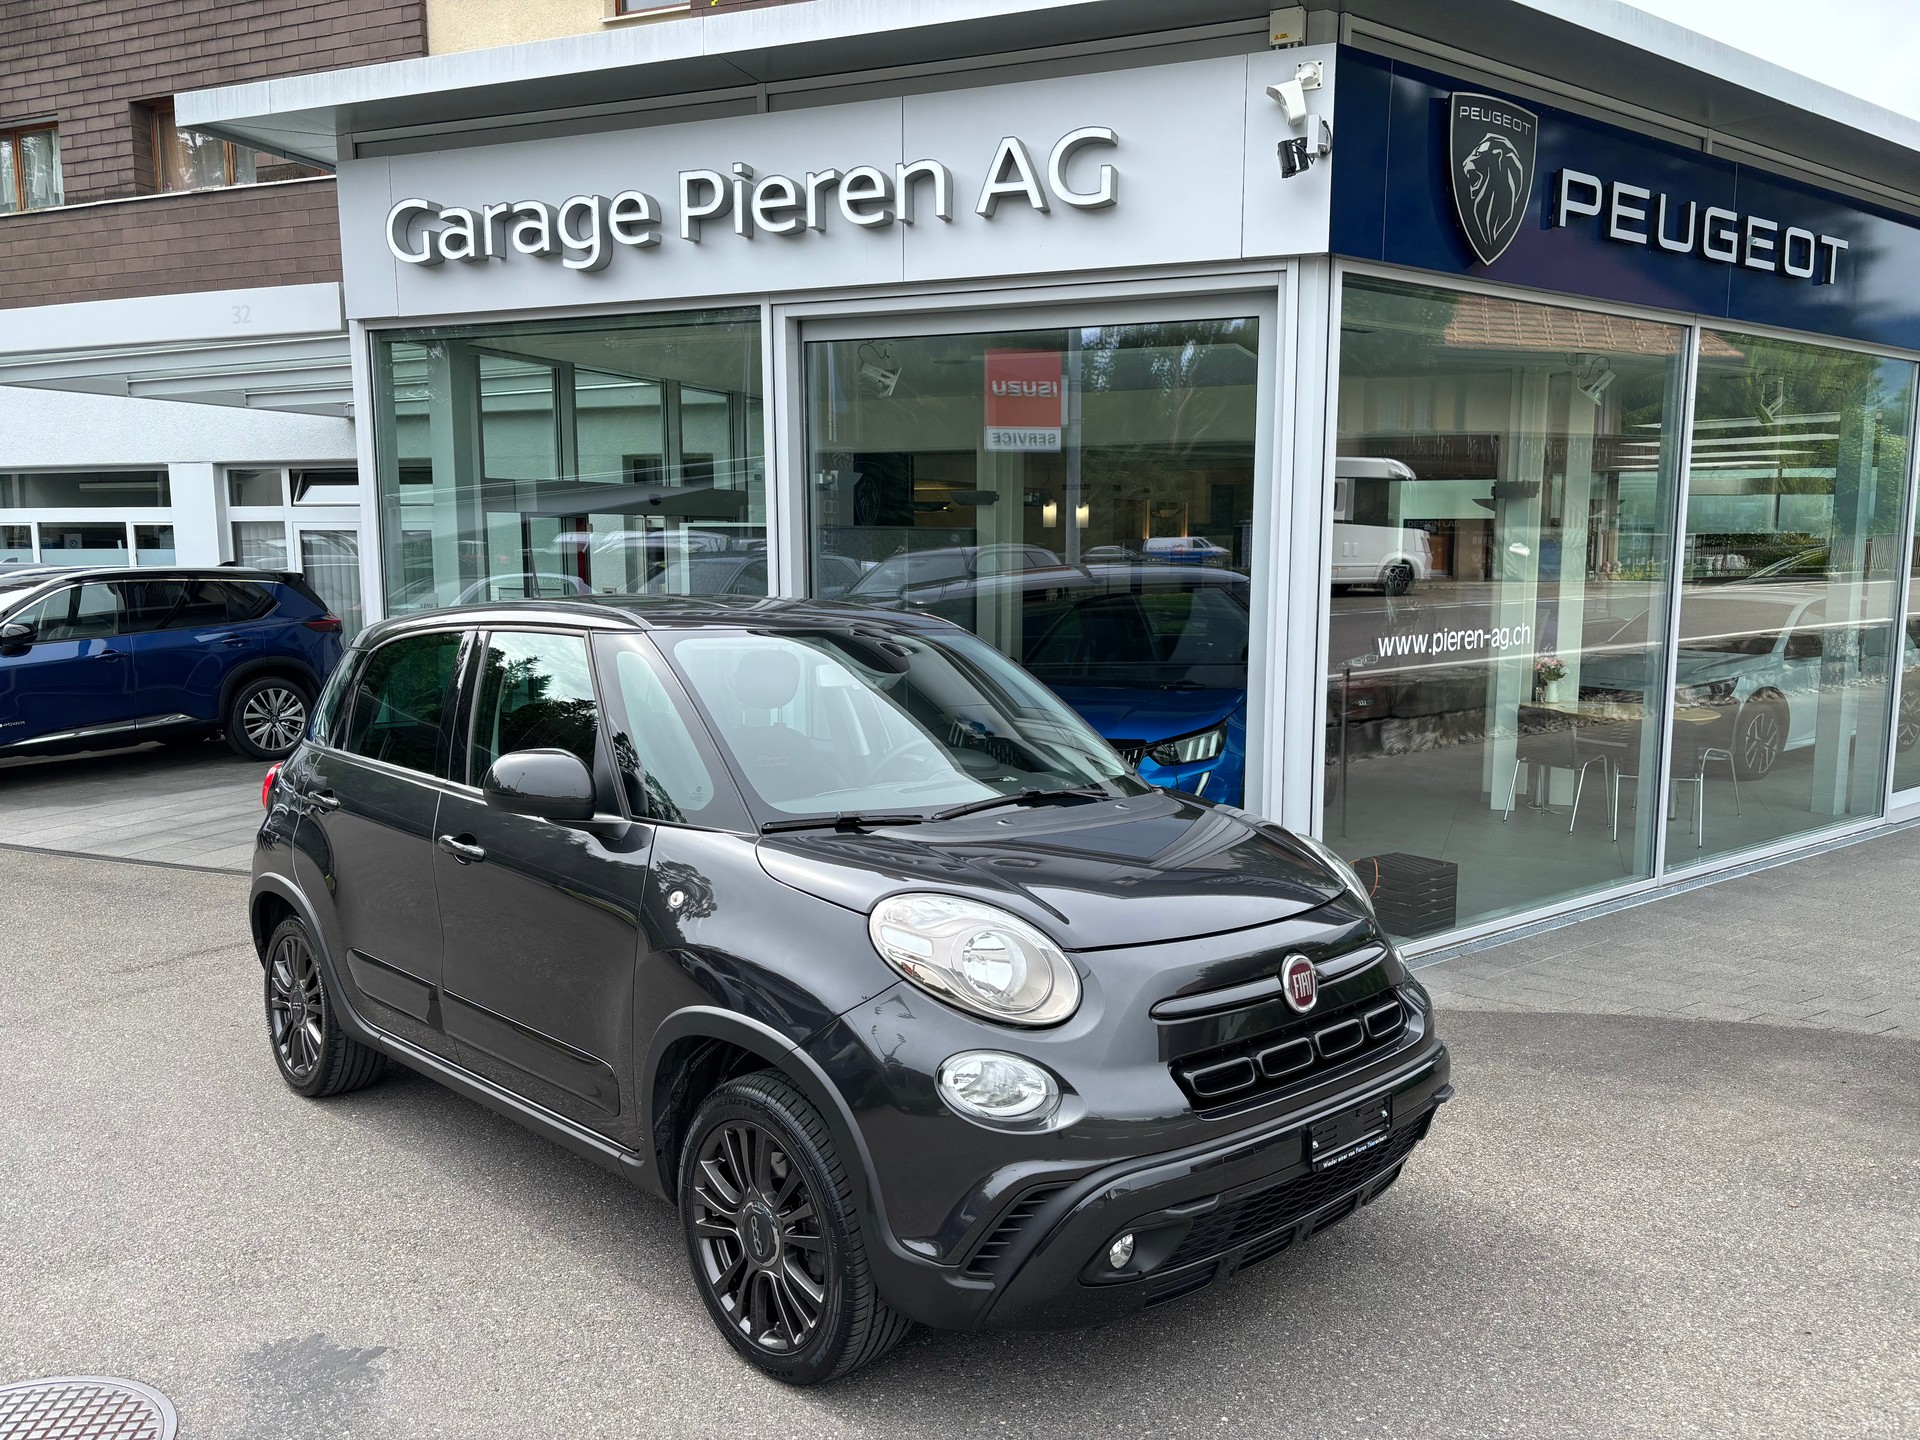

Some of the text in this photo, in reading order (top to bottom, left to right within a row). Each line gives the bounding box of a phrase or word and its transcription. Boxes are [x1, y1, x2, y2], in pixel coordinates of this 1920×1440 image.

[1459, 105, 1531, 135] PEUGEOT
[385, 126, 1119, 272] Garage Pieren AG
[1557, 168, 1849, 285] PEUGEOT
[231, 305, 252, 325] 32
[1378, 622, 1531, 657] www.pieren-ag.ch
[1292, 970, 1312, 999] FIAT
